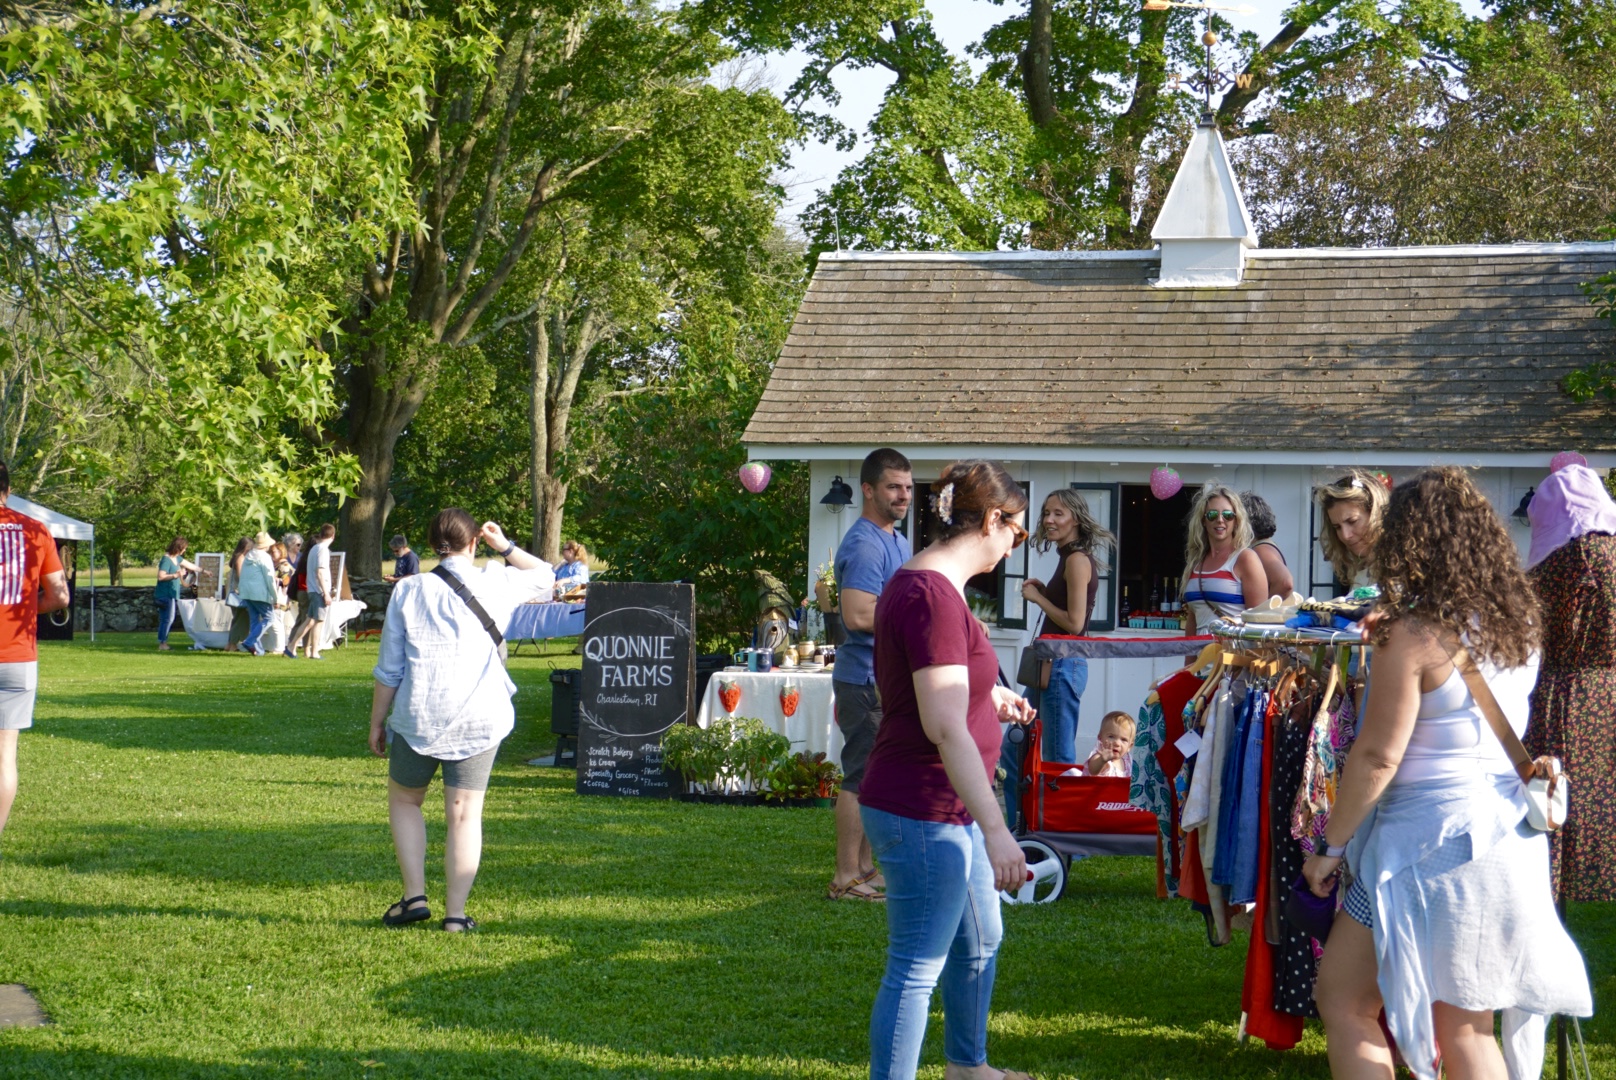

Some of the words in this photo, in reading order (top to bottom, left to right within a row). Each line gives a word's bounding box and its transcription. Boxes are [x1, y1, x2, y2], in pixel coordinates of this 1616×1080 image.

[1235, 73, 1254, 89] W
[584, 635, 675, 661] QUONNIE
[600, 664, 673, 688] FARMS
[644, 693, 658, 706] RI
[645, 743, 664, 752] Pizz
[598, 758, 617, 768] Cream
[615, 769, 639, 783] Grocery
